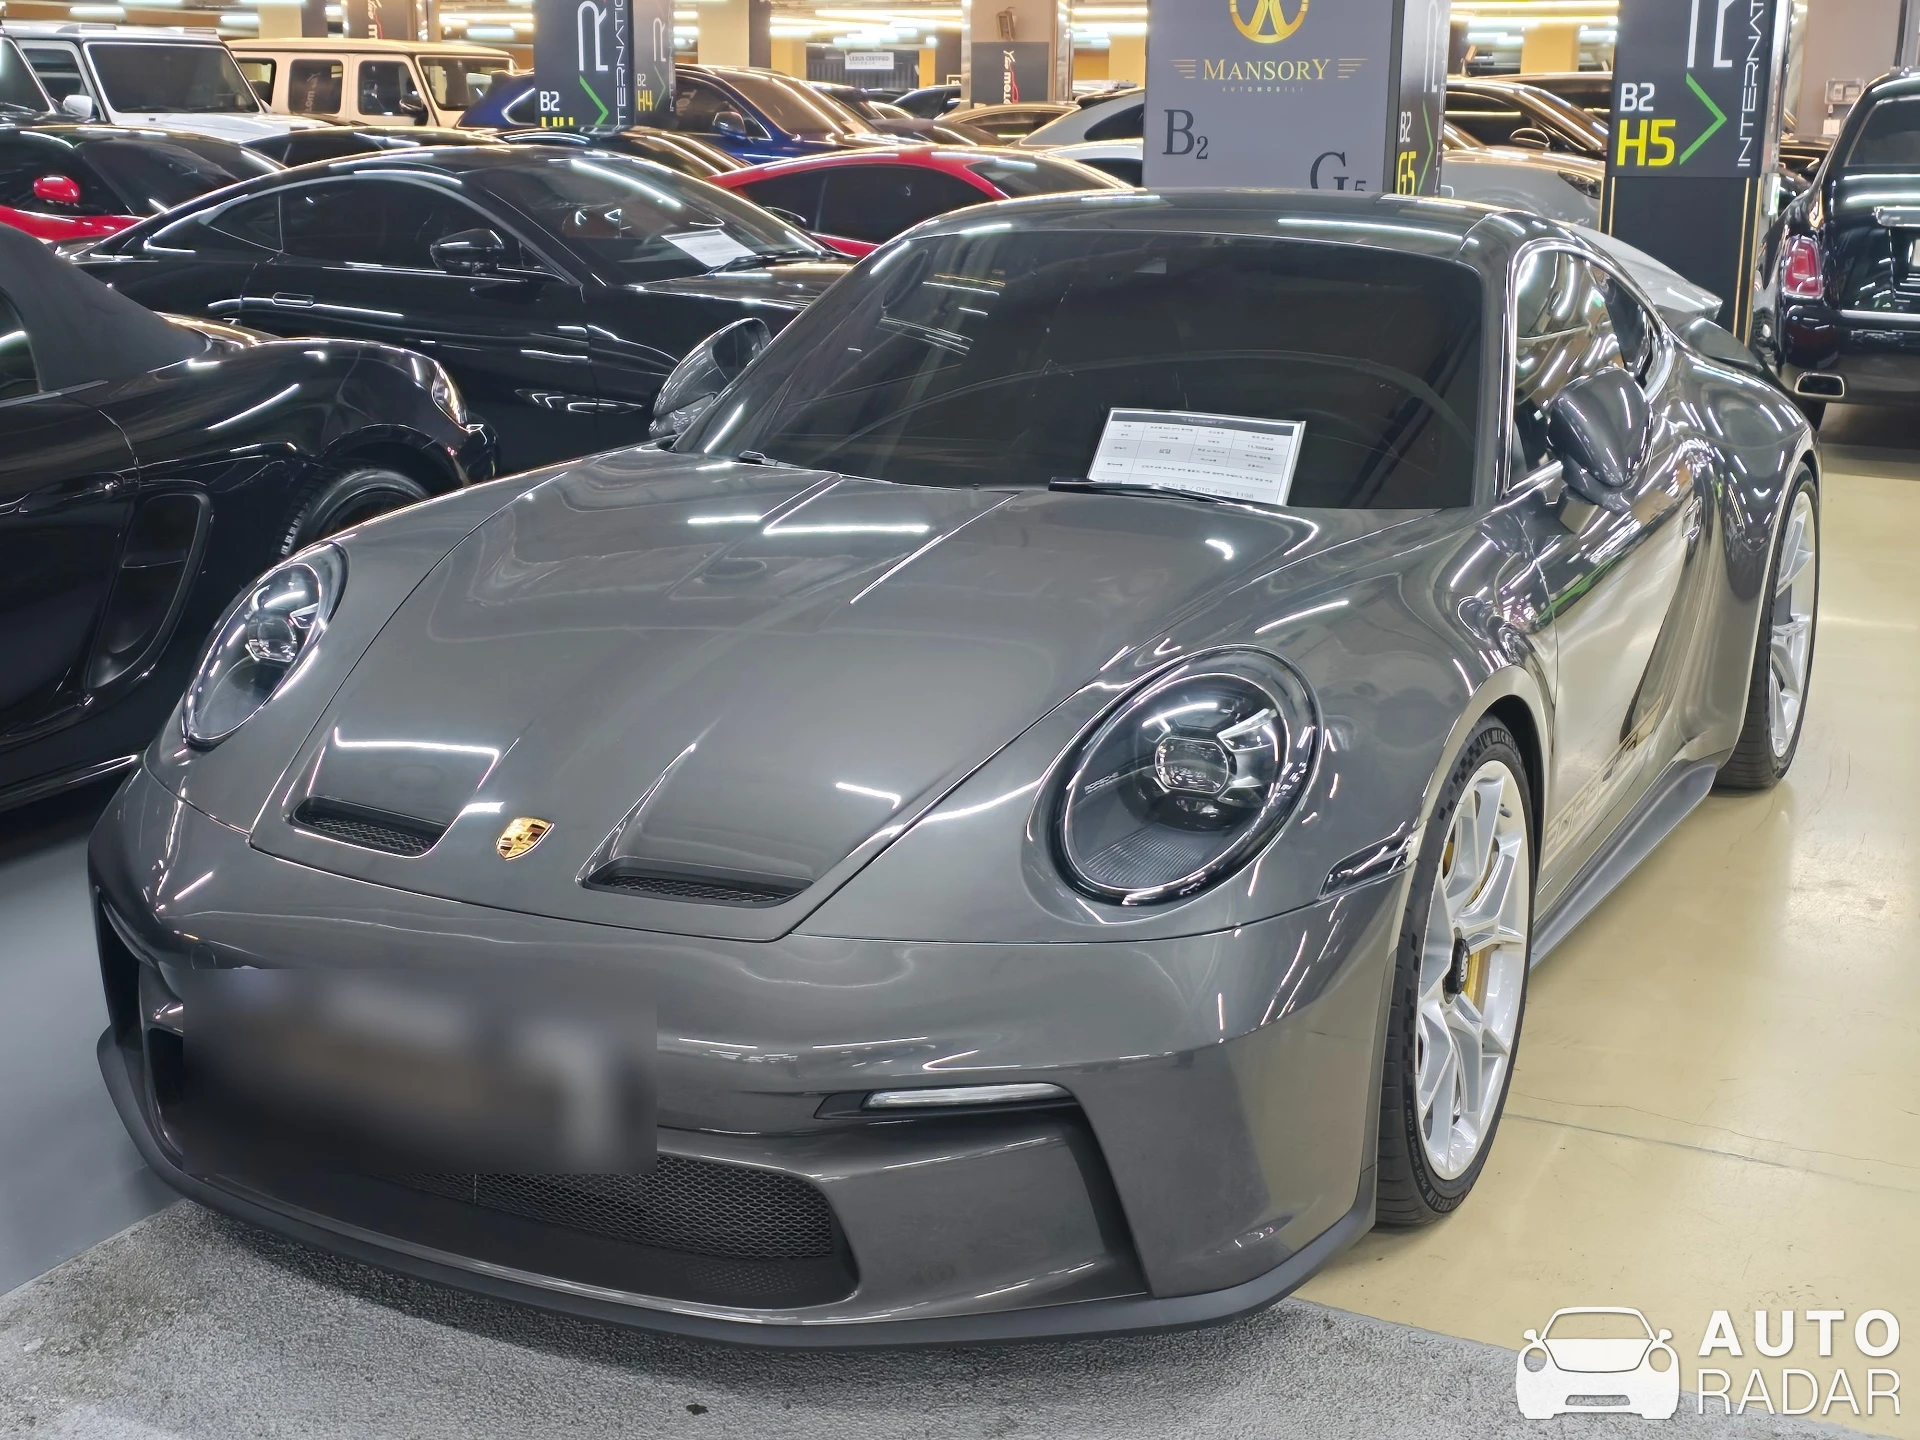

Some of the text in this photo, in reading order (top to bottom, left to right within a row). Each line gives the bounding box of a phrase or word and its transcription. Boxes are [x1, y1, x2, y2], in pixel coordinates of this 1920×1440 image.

[637, 73, 647, 87] B2
[1203, 58, 1331, 80] MANSORY
[540, 91, 560, 112] B2
[637, 90, 653, 112] H4
[1620, 82, 1655, 112] B2
[1400, 111, 1412, 143] B2
[1616, 119, 1676, 167] H5
[1397, 151, 1417, 195] G5
